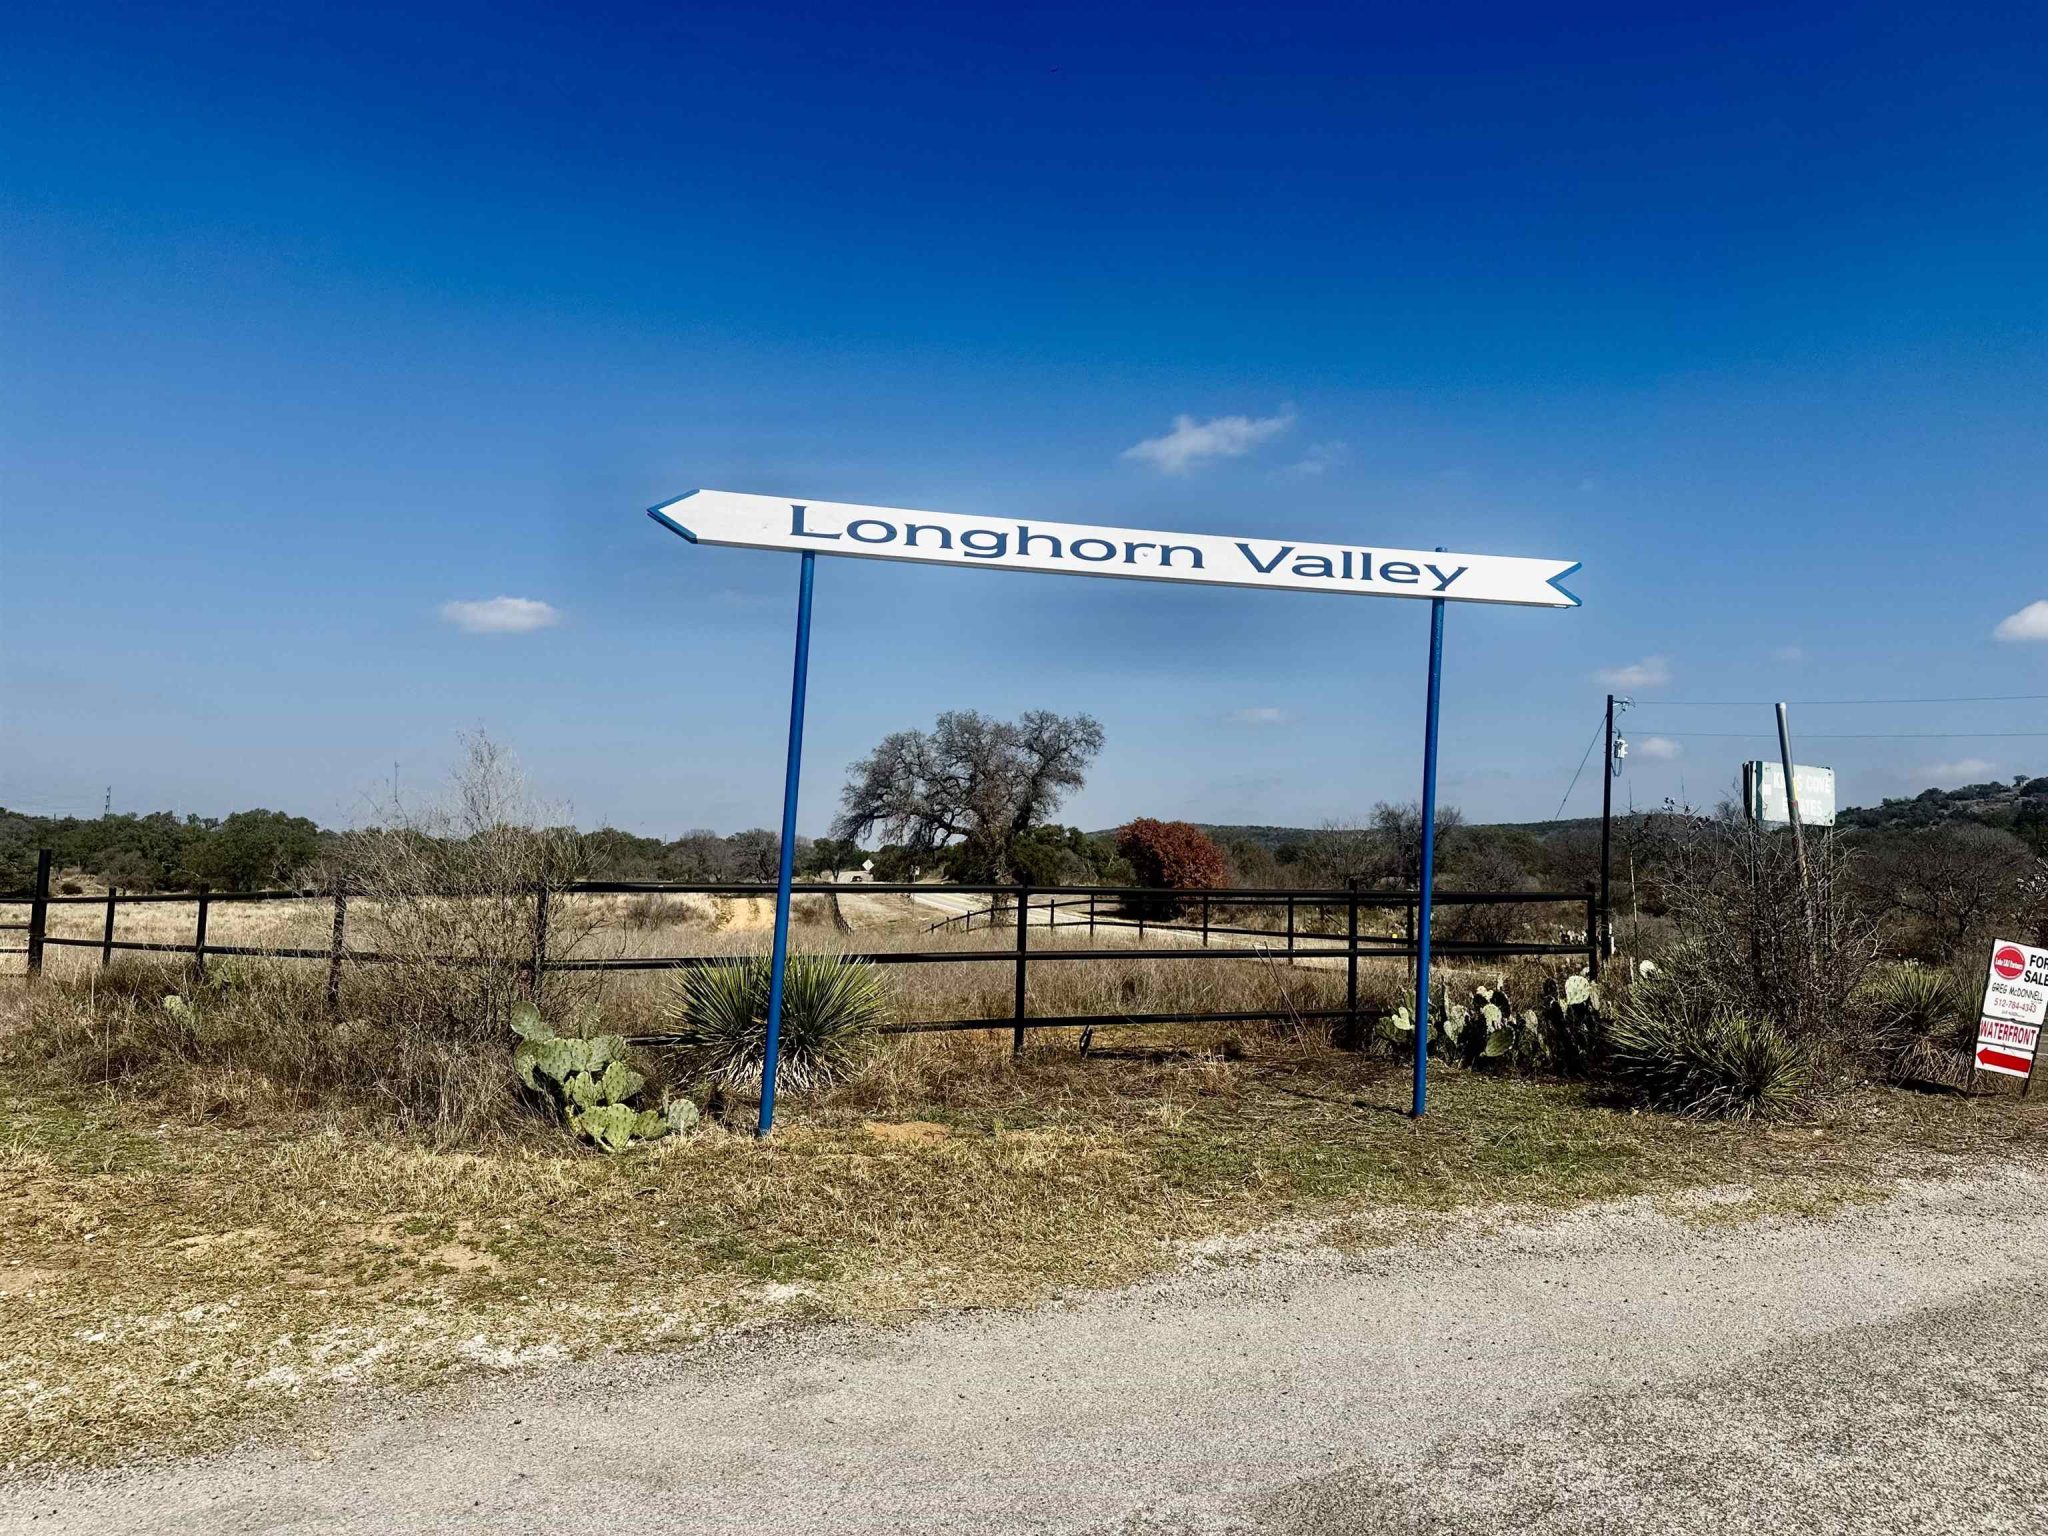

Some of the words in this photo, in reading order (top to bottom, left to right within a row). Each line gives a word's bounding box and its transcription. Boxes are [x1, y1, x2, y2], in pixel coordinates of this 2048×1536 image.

[789, 504, 1205, 570] Longhorn
[1235, 542, 1469, 592] Valley
[1992, 982, 2008, 994] GREG
[1980, 1020, 2036, 1046] WATERFRONT
